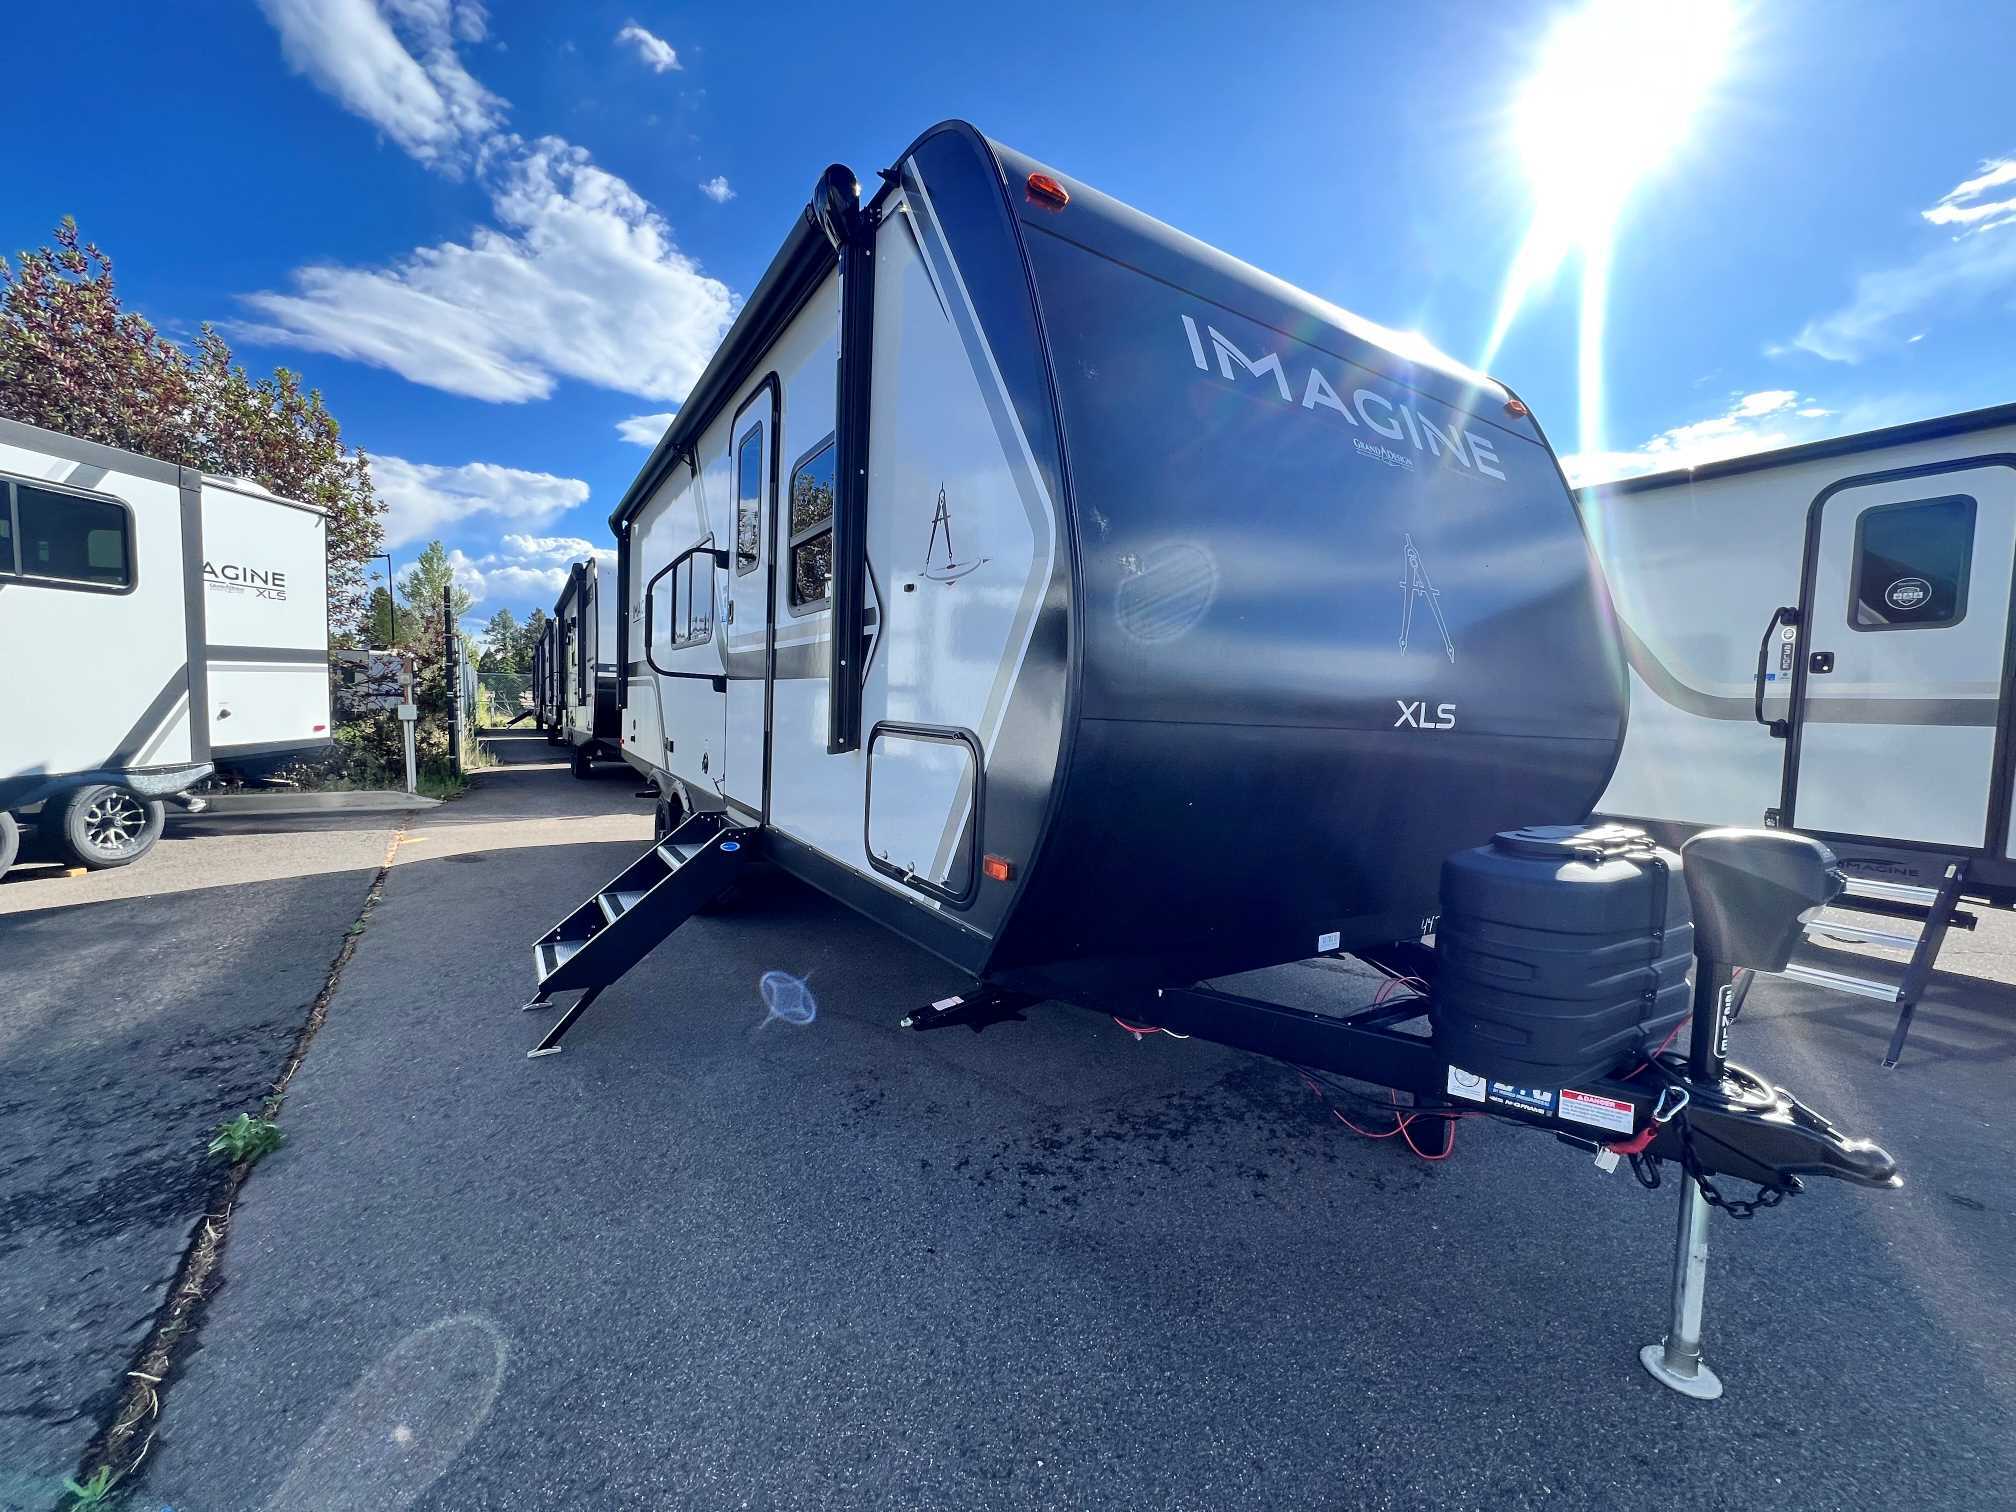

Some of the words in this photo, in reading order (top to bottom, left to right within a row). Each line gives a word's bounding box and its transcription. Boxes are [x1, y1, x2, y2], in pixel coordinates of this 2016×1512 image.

[1181, 313, 1507, 481] IMAGINE
[256, 588, 287, 601] XLS
[1394, 700, 1457, 729] XLS
[1583, 1095, 1616, 1109] DANGER
